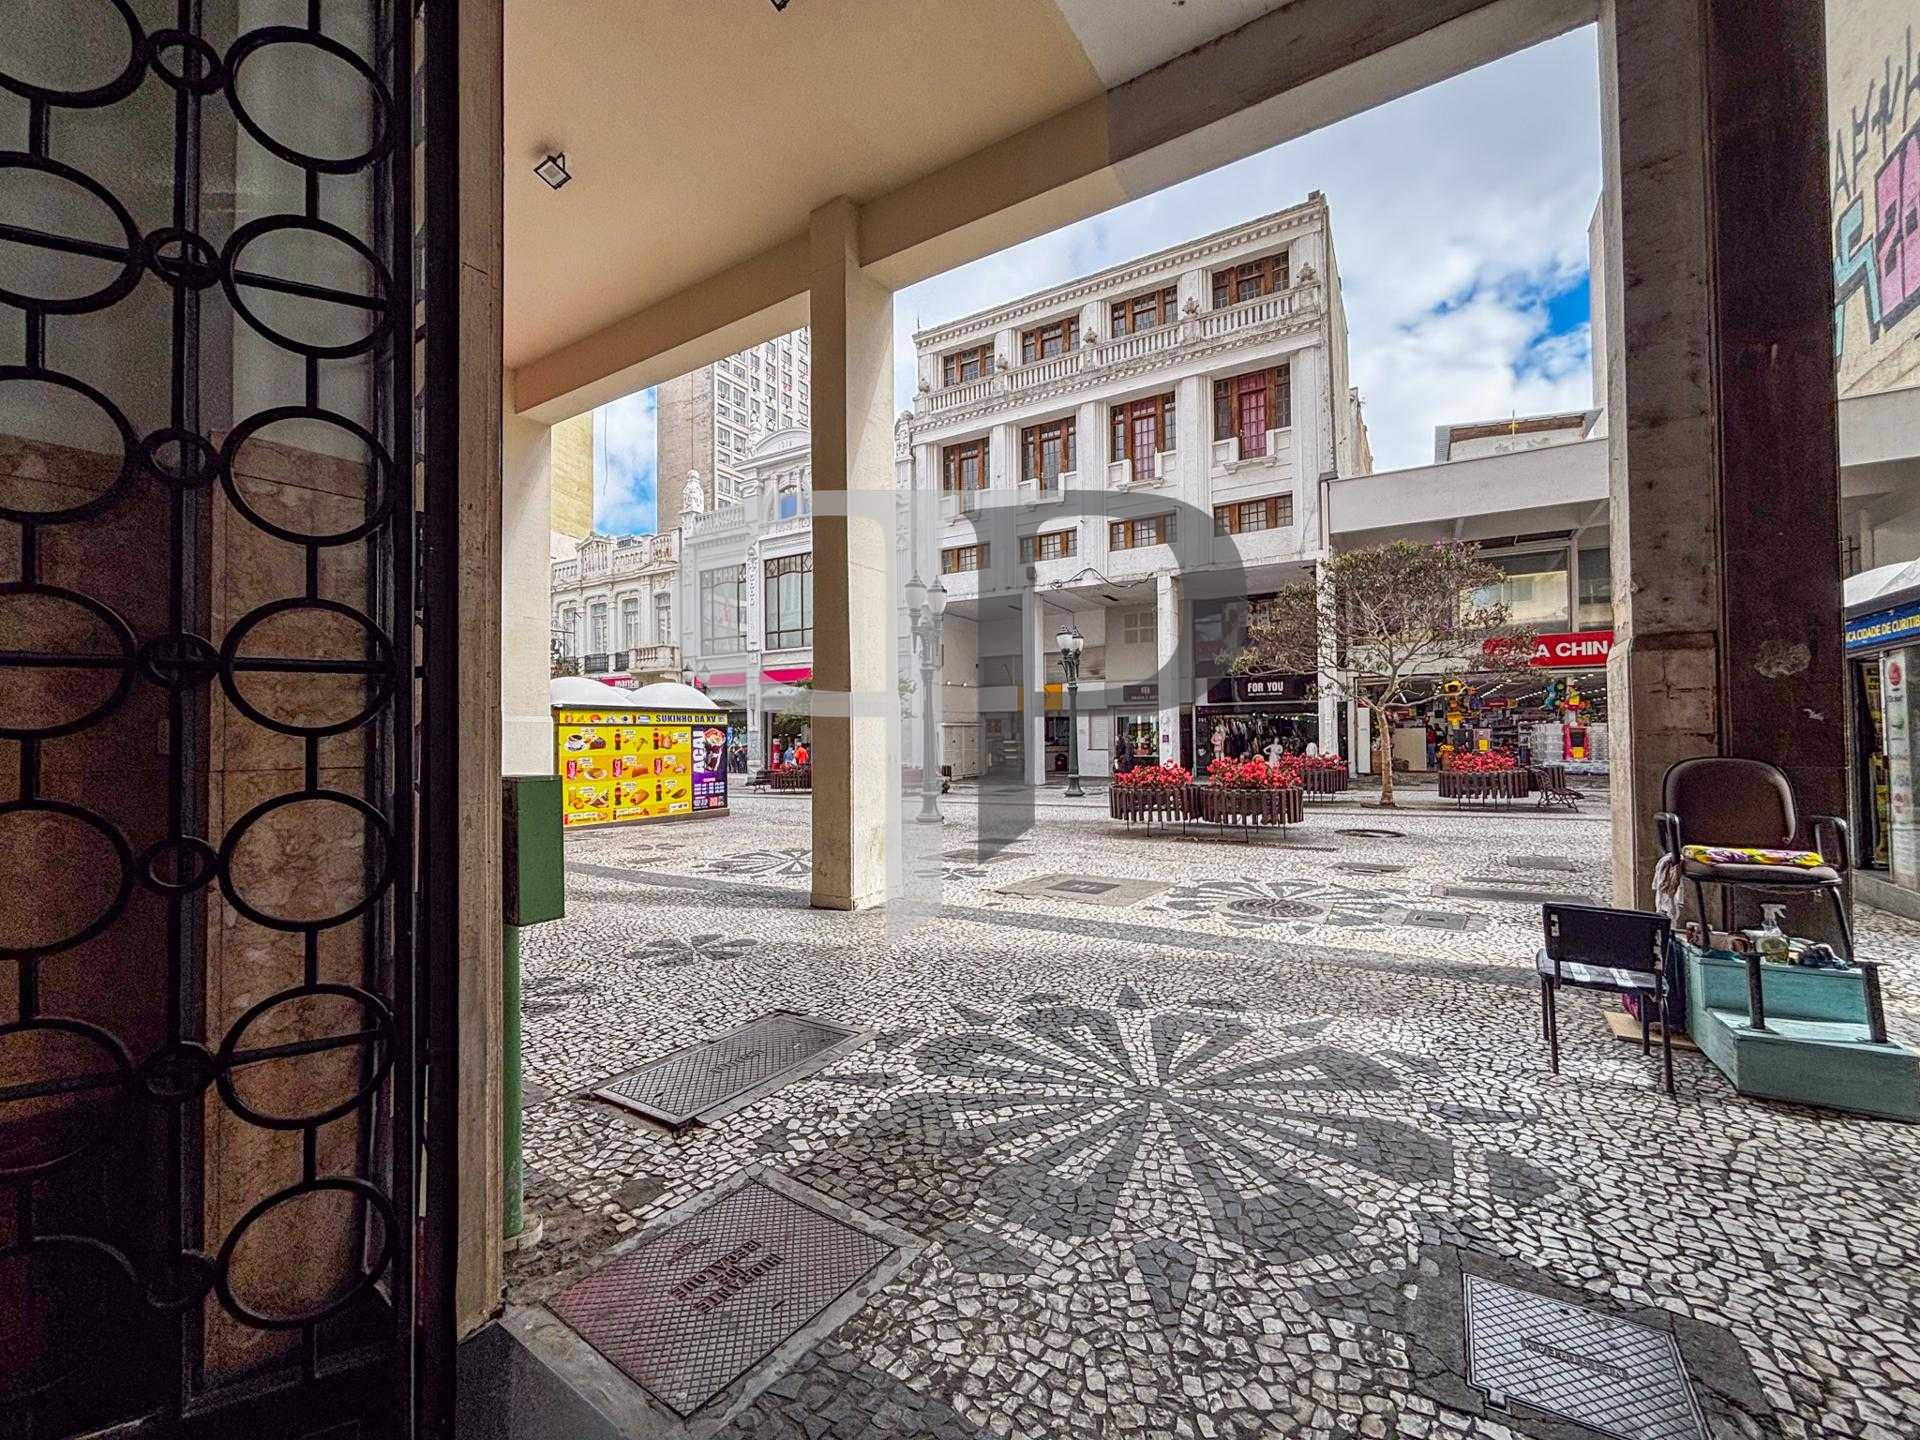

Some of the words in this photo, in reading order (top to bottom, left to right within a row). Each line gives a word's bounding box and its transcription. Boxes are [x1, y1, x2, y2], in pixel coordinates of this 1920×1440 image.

[1247, 682, 1264, 692] FOR
[1267, 681, 1284, 691] YOU
[656, 714, 693, 723] SUKINHO
[706, 714, 716, 722] XV
[671, 1239, 761, 1299] RECALQUE
[693, 1253, 784, 1313] HIDRANTE
